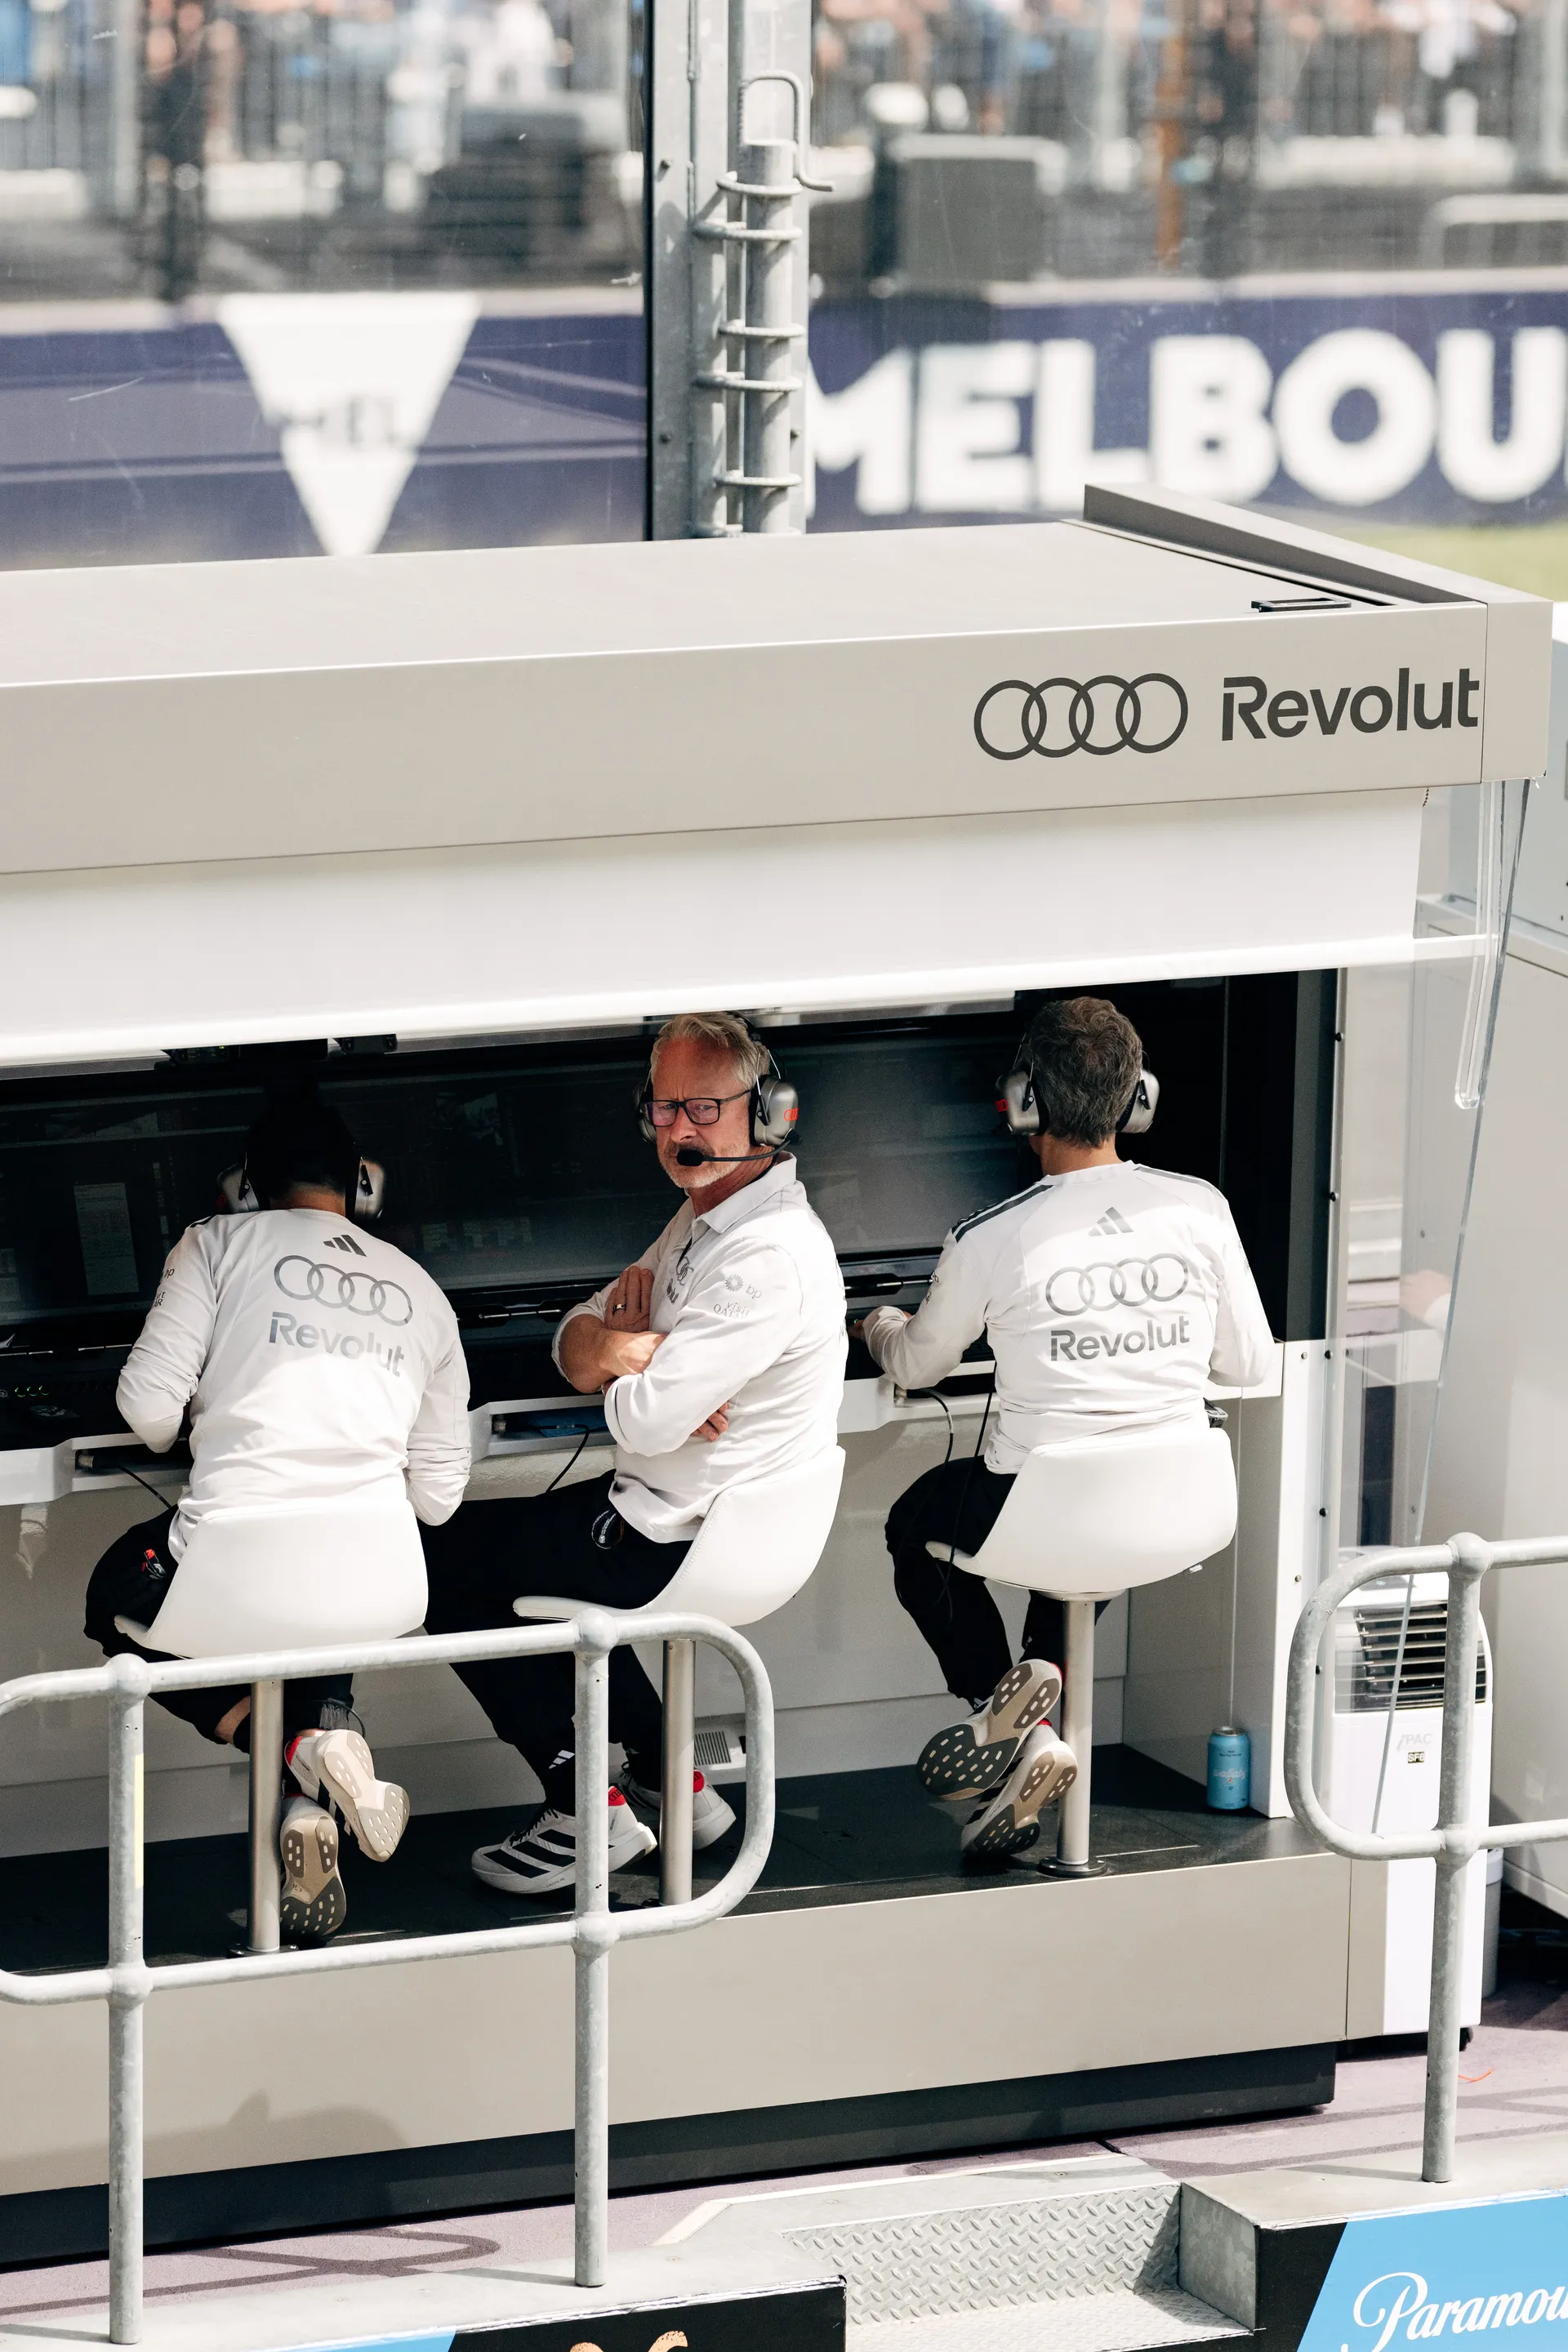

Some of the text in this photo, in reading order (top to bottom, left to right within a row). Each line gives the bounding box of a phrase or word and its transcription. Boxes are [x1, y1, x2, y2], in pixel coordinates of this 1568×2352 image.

[805, 325, 1568, 516] MELBOU
[1222, 667, 1480, 742] Revolut
[746, 1284, 763, 1299] bp
[269, 1311, 405, 1377] Revolut
[1050, 1315, 1191, 1361] Revolut
